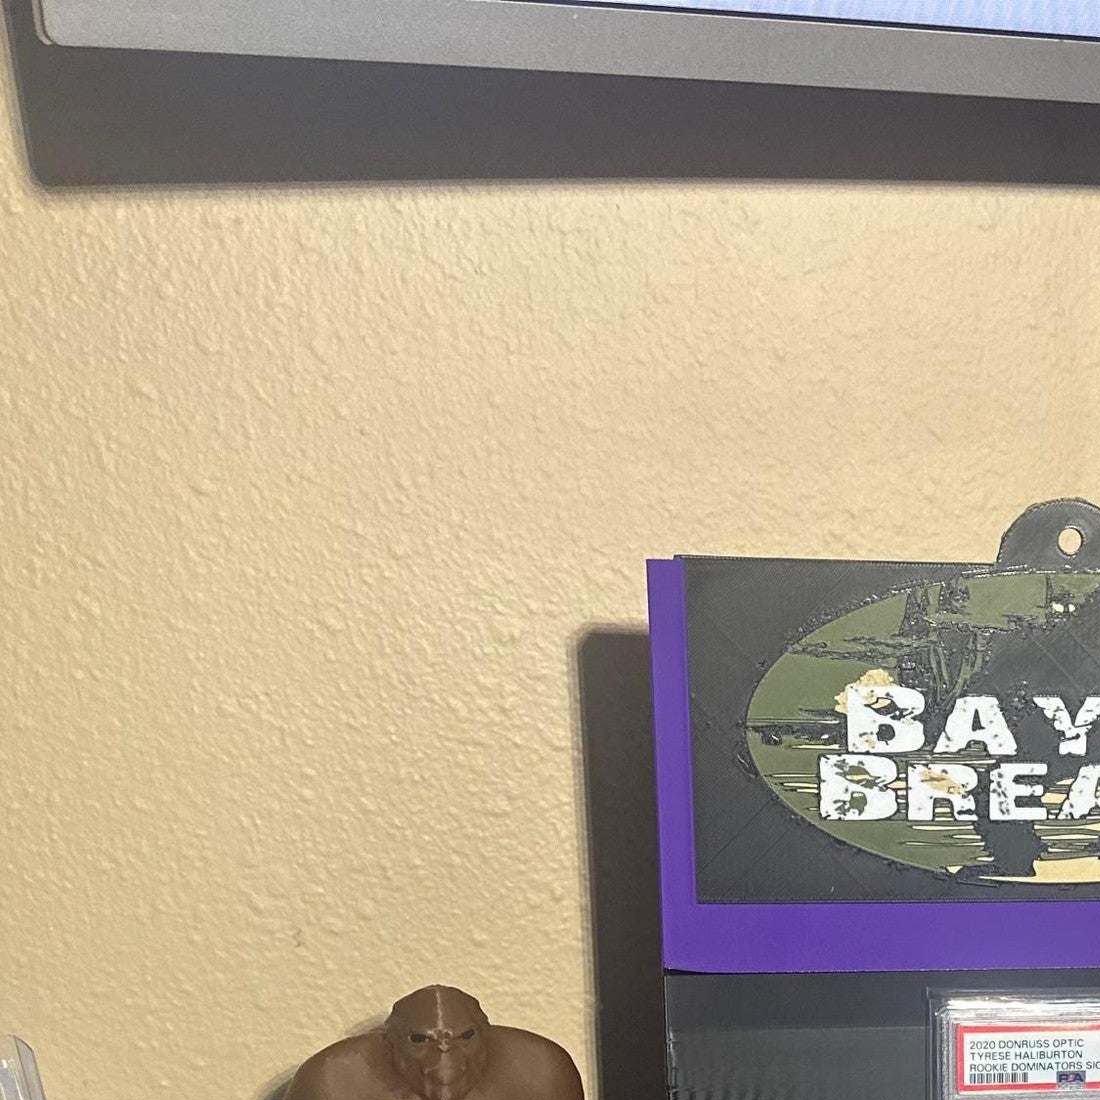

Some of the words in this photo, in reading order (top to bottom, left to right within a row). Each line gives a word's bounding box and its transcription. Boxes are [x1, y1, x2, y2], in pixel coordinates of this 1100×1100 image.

[969, 1040, 996, 1050] 2020
[998, 1039, 1050, 1049] DONRUSS
[1052, 1038, 1084, 1048] OPTIC
[970, 1051, 1011, 1061] TYRESE
[1014, 1050, 1083, 1060] HALIBURTON
[969, 1063, 1008, 1073] ROOKIE
[1011, 1061, 1083, 1072] DOMINATORS
